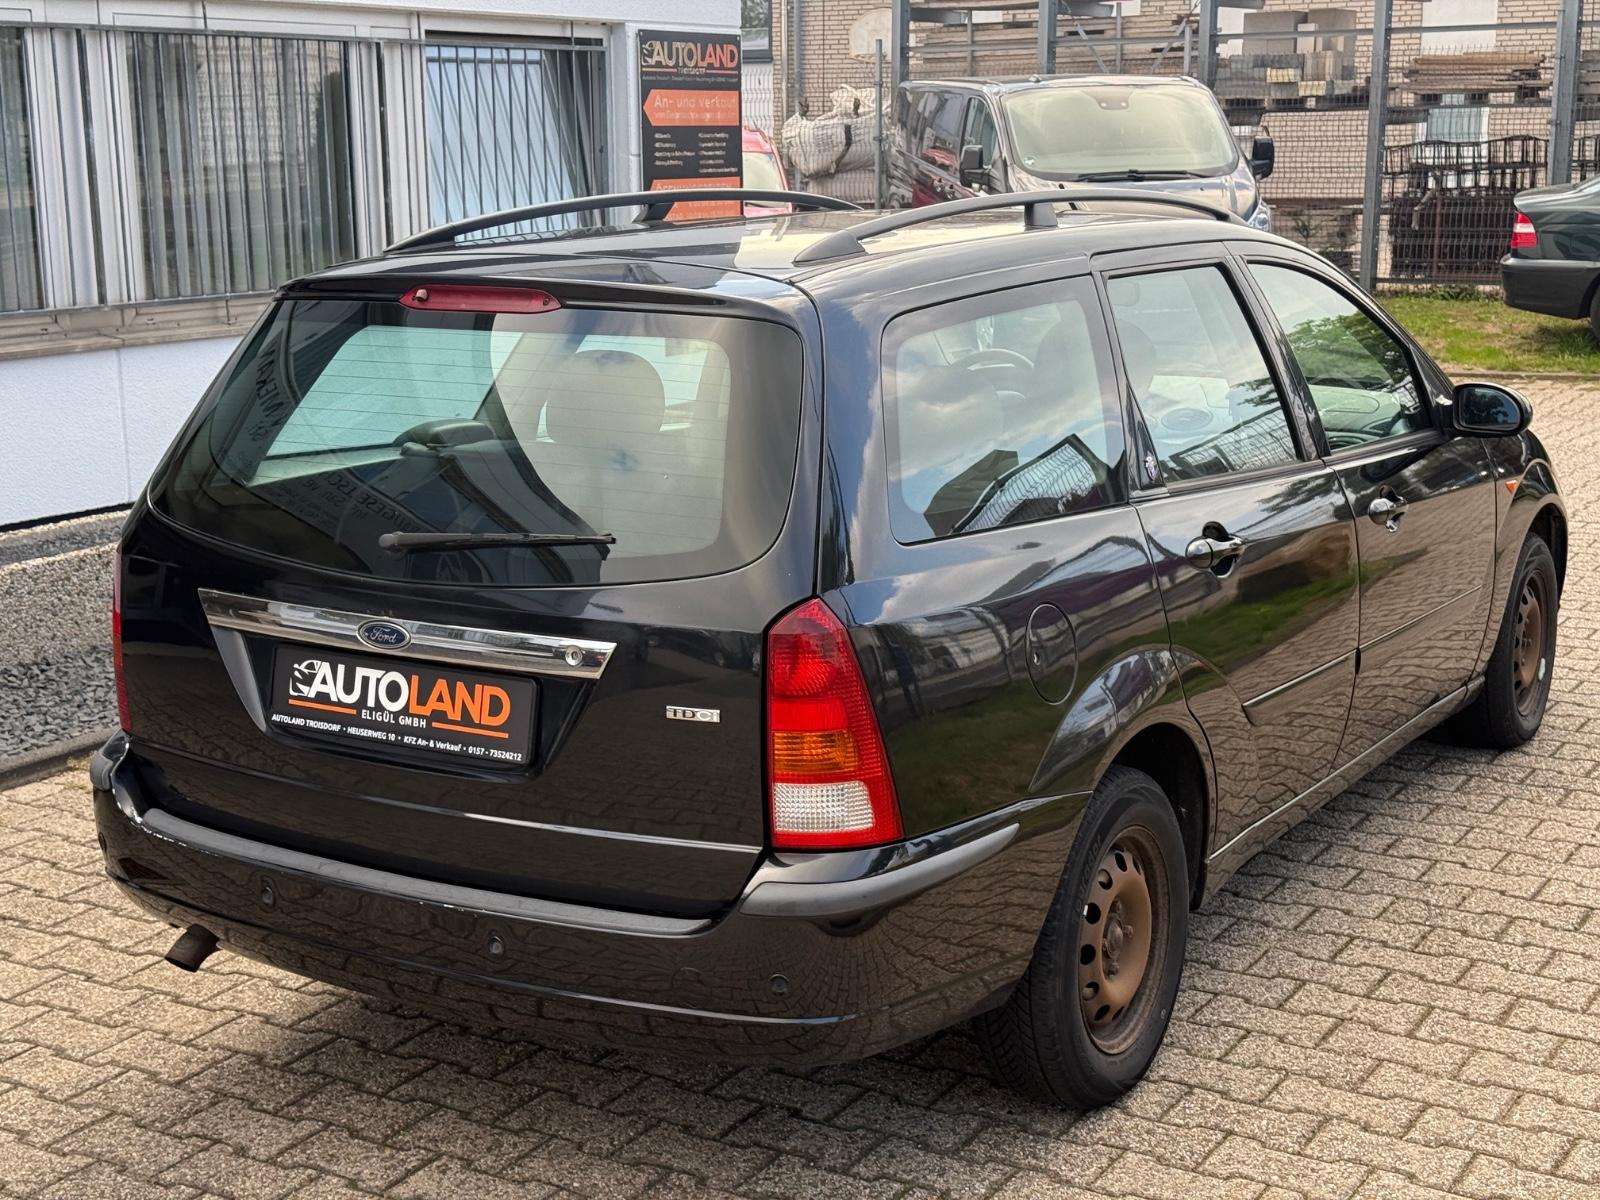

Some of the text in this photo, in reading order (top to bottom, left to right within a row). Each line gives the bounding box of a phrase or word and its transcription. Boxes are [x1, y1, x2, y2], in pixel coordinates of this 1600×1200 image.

[652, 41, 739, 68] AUTOLAND
[654, 96, 674, 108] An-
[370, 626, 397, 643] Ford
[307, 661, 511, 727] AUTOLAND
[361, 709, 427, 729] ELIGÜL GMBH
[271, 713, 305, 726] AUTOLAND
[306, 719, 341, 732] TROISDORF
[347, 726, 387, 740] HEUSERWEG
[388, 733, 396, 741] 10
[403, 735, 416, 745] KFZ
[435, 741, 462, 752] Verkauf
[468, 746, 485, 755] 0157
[489, 749, 523, 761] 73524212
